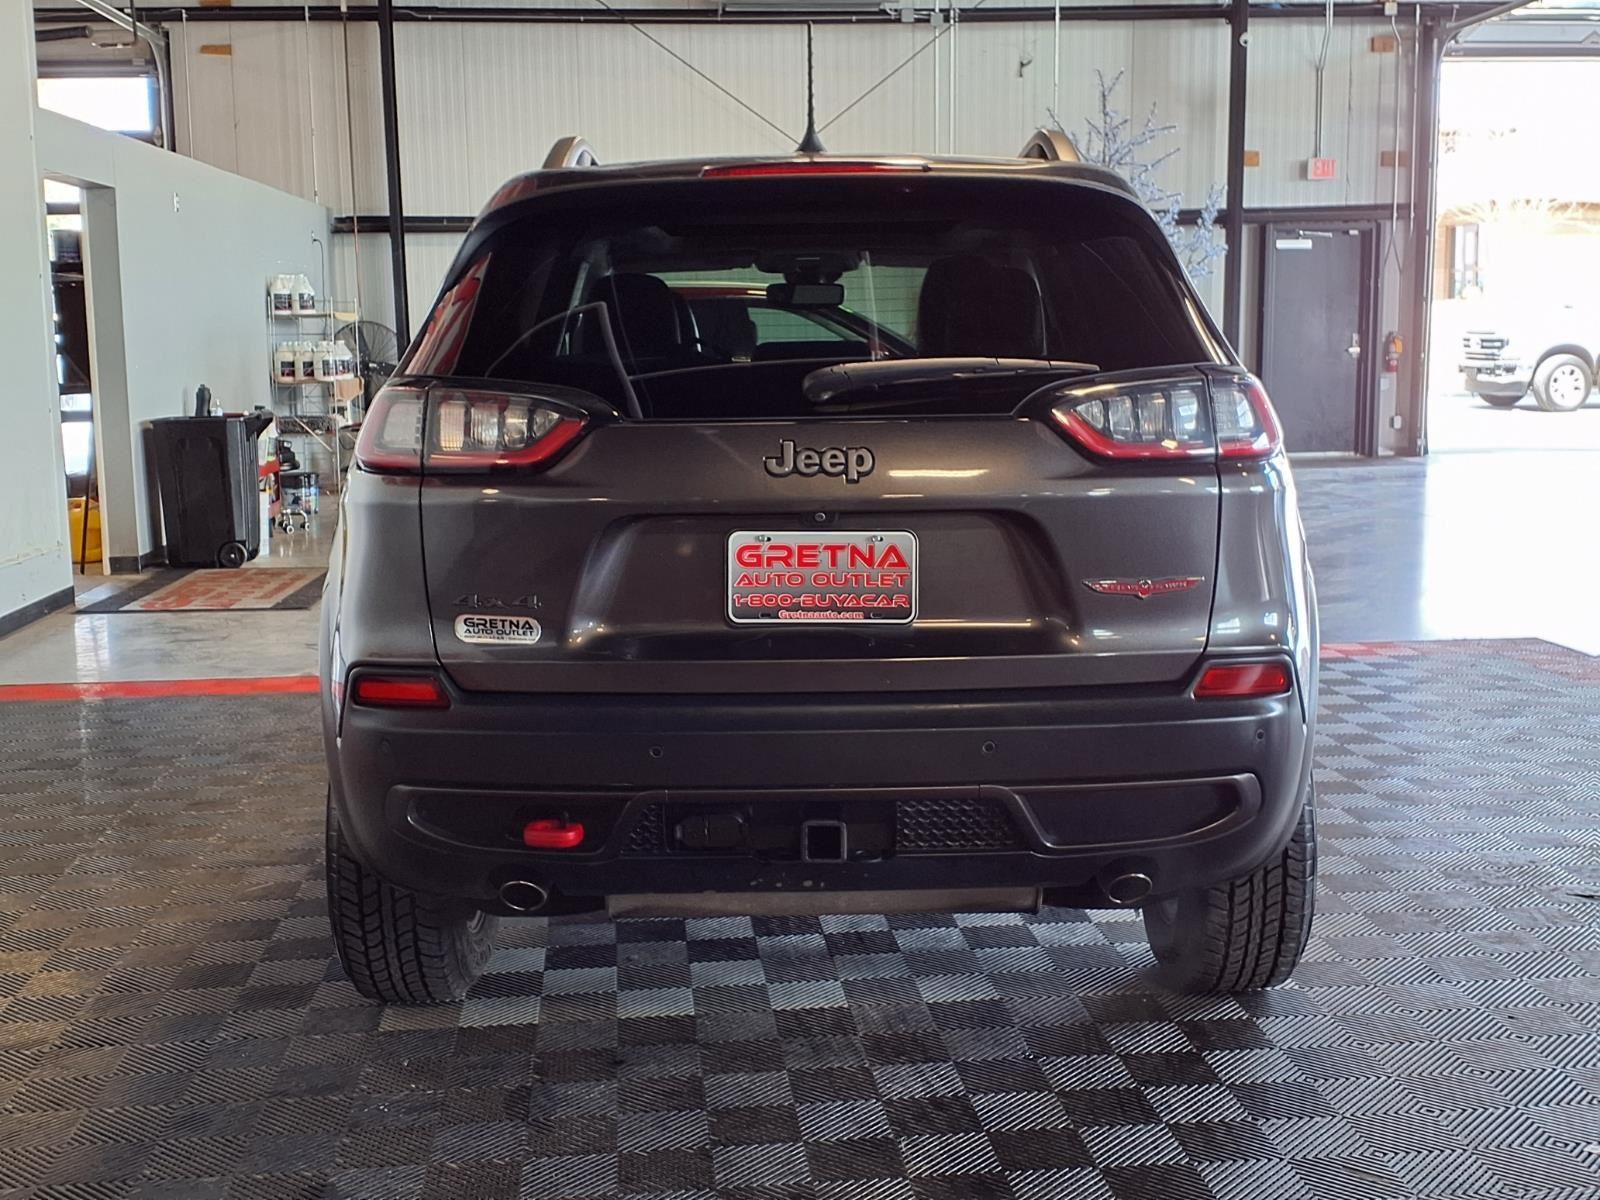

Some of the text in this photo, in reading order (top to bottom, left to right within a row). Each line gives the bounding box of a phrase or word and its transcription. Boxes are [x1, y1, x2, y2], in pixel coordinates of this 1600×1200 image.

[1313, 159, 1335, 177] EXIT
[763, 439, 875, 484] Jeep
[735, 543, 910, 569] GRETNA
[734, 573, 910, 588] AUTO OUTLET
[733, 594, 910, 607] 1-800-BUYACAR
[463, 617, 534, 630] GRETNA
[496, 629, 534, 637] OUTLET
